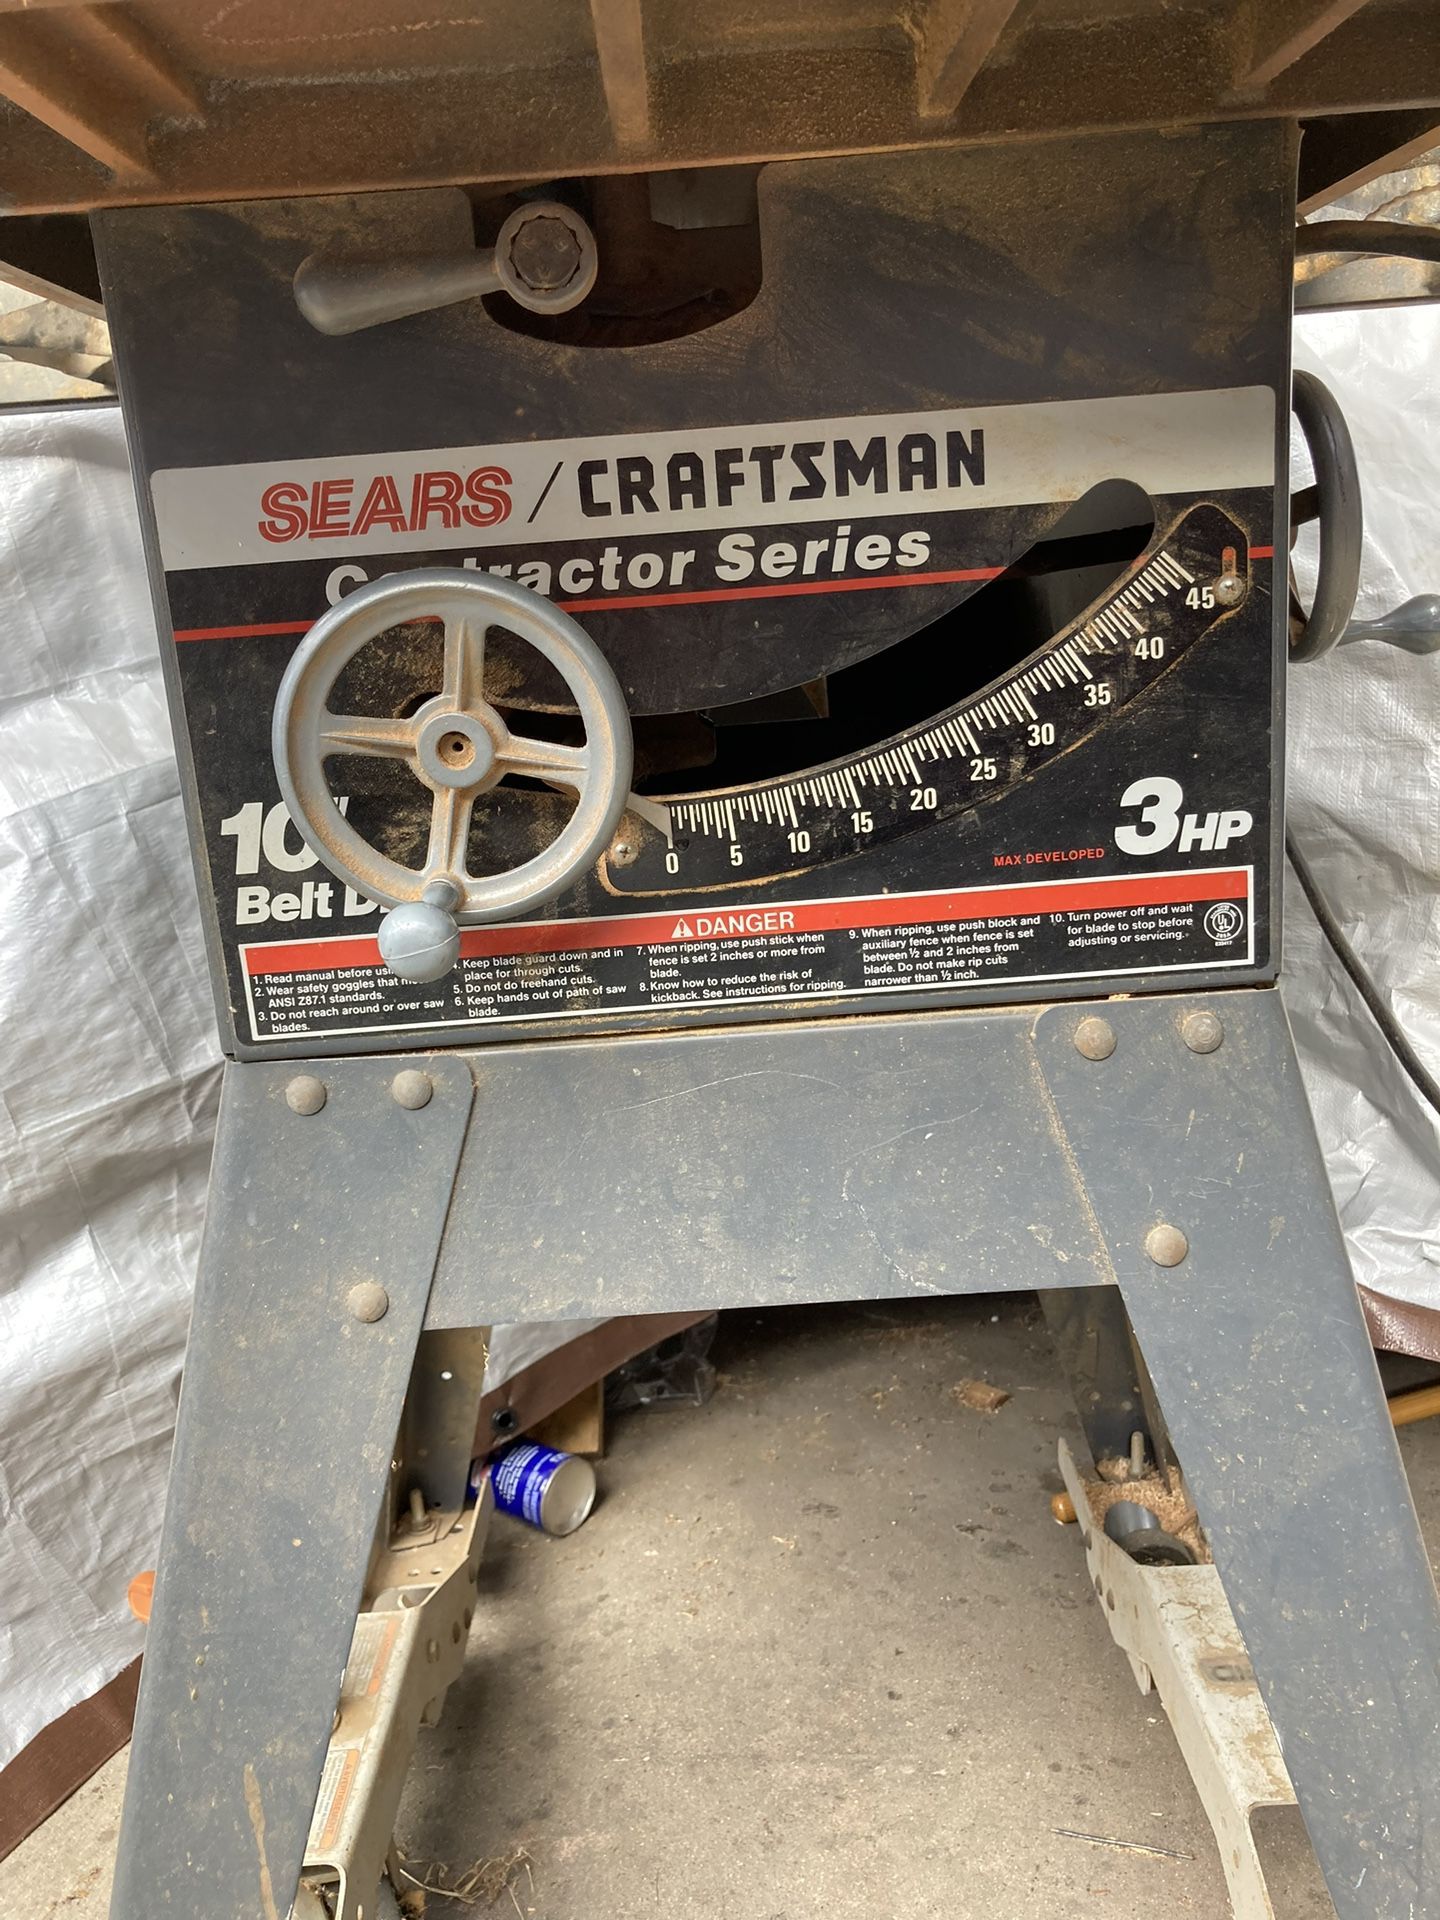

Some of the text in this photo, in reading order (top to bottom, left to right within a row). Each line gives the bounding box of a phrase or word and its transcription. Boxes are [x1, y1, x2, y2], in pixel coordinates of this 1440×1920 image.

[258, 466, 512, 545] SEARS
[578, 429, 986, 521] CRAFTSMAN
[717, 527, 932, 584] Series
[1185, 586, 1215, 609] 45
[1135, 636, 1164, 660] 40
[1083, 683, 1112, 707] 35
[1027, 723, 1055, 747] 30
[970, 758, 998, 781] 25
[910, 787, 938, 811] 20
[851, 810, 874, 834] 15
[787, 830, 811, 854] 10
[665, 850, 680, 875] 0
[729, 842, 744, 868] 5
[993, 847, 1105, 867] MAX DEVELOPED
[236, 881, 334, 925] Belt
[1049, 903, 1192, 923] 10. Turn power off and wait
[696, 911, 795, 937] DANGER
[848, 916, 1040, 939] 9. When ripping, use push block and
[1067, 916, 1193, 935] for blade to stop before
[637, 932, 824, 955] 7. When ripping, use push stick when
[862, 928, 1034, 952] auxiliary fence when fence is set
[1068, 929, 1185, 949] adjusting or servicing.
[462, 958, 489, 971] Keep
[492, 955, 521, 967] blade
[525, 952, 555, 966] guard
[559, 950, 587, 961] down
[591, 948, 610, 959] and
[613, 947, 623, 957] in
[648, 944, 825, 966] fence is set 2 inches or more from
[862, 950, 907, 962] between
[923, 947, 943, 958] and
[946, 946, 953, 956] 2
[956, 943, 991, 955] inches
[993, 941, 1019, 952] from
[253, 975, 262, 985] 1.
[264, 973, 292, 984] Read
[295, 970, 335, 982] manual
[337, 967, 372, 978] before
[464, 962, 583, 982] place for through cuts.
[649, 967, 681, 979] blade.
[863, 955, 1008, 974] blade. Do not make rip cuts
[254, 988, 264, 997] 2.
[265, 985, 293, 996] Wear
[296, 982, 328, 996] safety
[331, 978, 375, 993] goggles
[377, 977, 398, 987] that
[453, 974, 595, 994] 5. Do not do freehand cuts.
[639, 969, 812, 992] 8. Know how to reduce the risk of
[864, 976, 912, 986] narrower
[914, 972, 938, 983] than
[954, 969, 979, 980] inch.
[268, 990, 385, 1008] ANSI Z87.1 standards.
[454, 985, 626, 1007] 6. Keep hands out of path of saw
[651, 979, 846, 1003] kickback. See instructions for ripping.
[258, 999, 444, 1021] 3. Do not reach around or over saw
[468, 1006, 500, 1018] blade.
[271, 1021, 310, 1033] blades.
